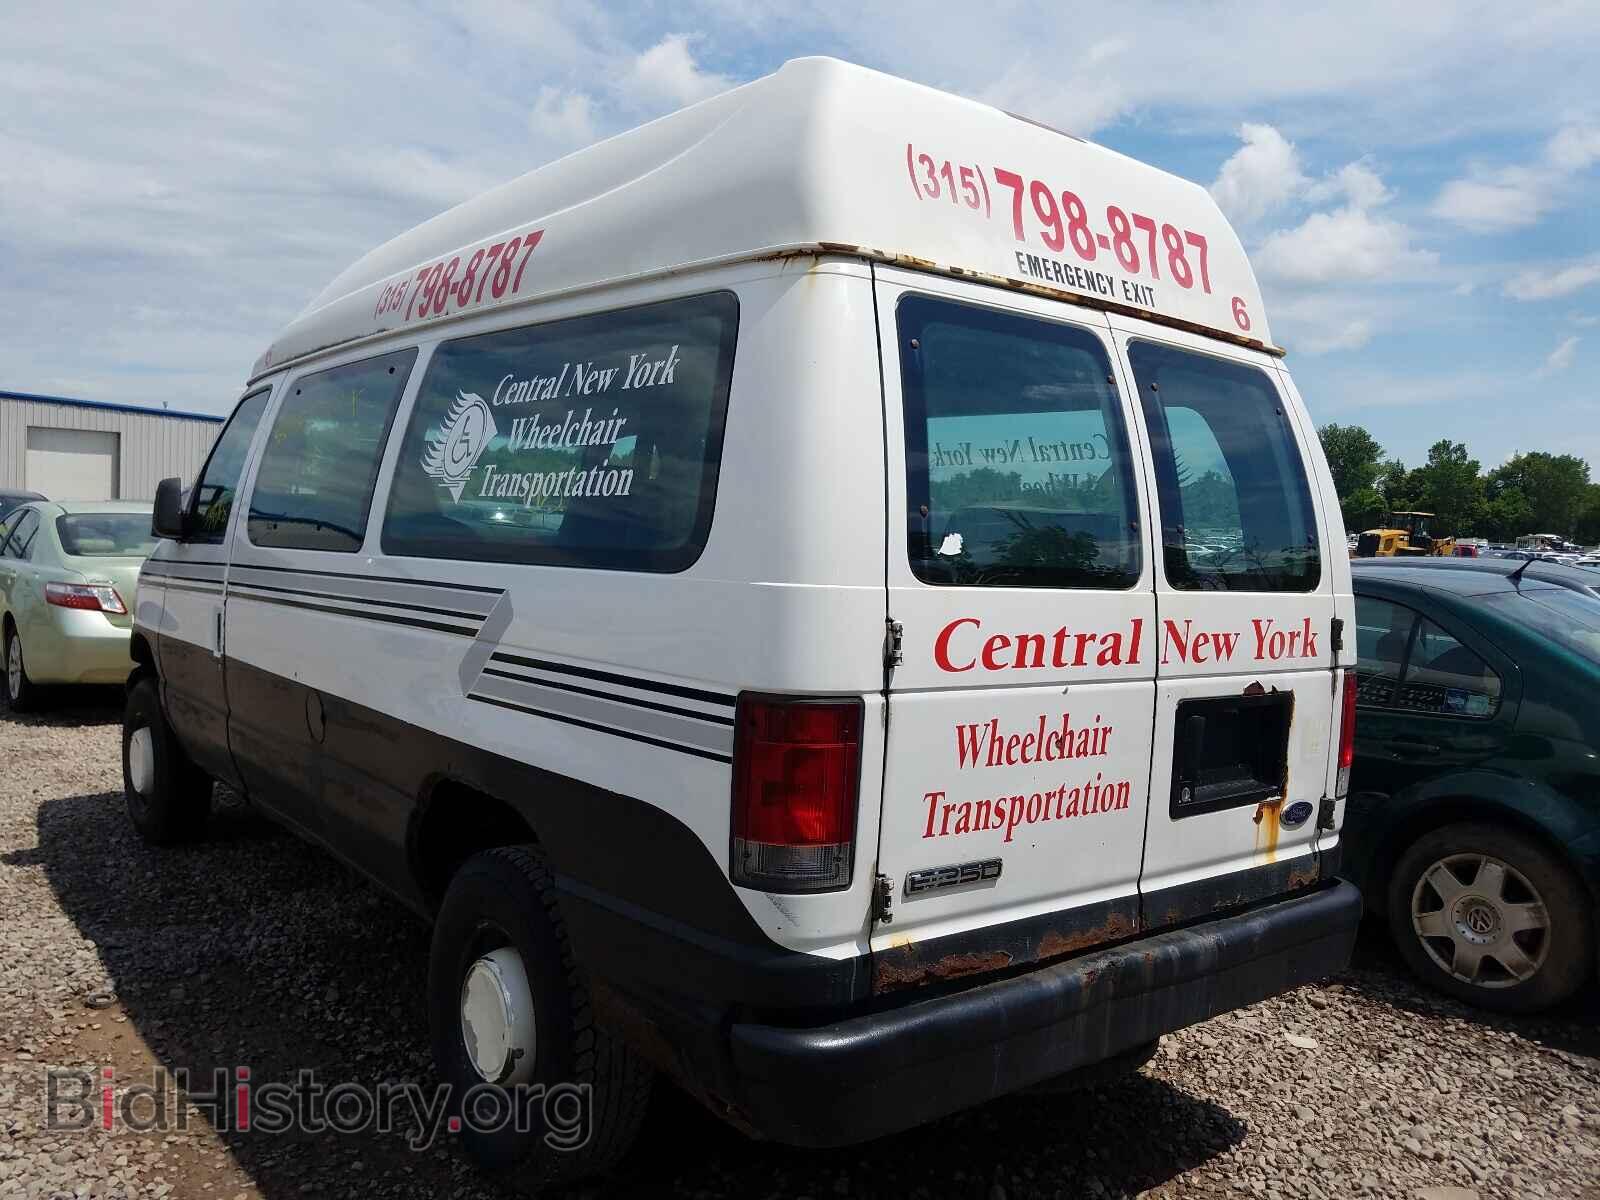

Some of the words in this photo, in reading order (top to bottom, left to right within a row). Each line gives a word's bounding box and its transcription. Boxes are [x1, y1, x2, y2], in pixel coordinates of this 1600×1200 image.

[907, 143, 991, 218] (315)
[993, 167, 1212, 295] 798-8787
[374, 274, 412, 320] (315)
[405, 229, 545, 321] 798-8787
[1015, 251, 1115, 297] EMERGENCY
[1121, 279, 1155, 307] EXIT
[1231, 296, 1250, 331] 6
[493, 363, 570, 406] Central
[565, 361, 619, 397] New
[622, 344, 680, 389] York
[508, 408, 626, 453] Wheelchair
[477, 459, 634, 508] Transportation
[934, 616, 1145, 674] Central
[1161, 618, 1241, 665] New
[1251, 616, 1318, 661] York
[955, 712, 1113, 770] Wheelchair
[922, 772, 1132, 843] Transportation
